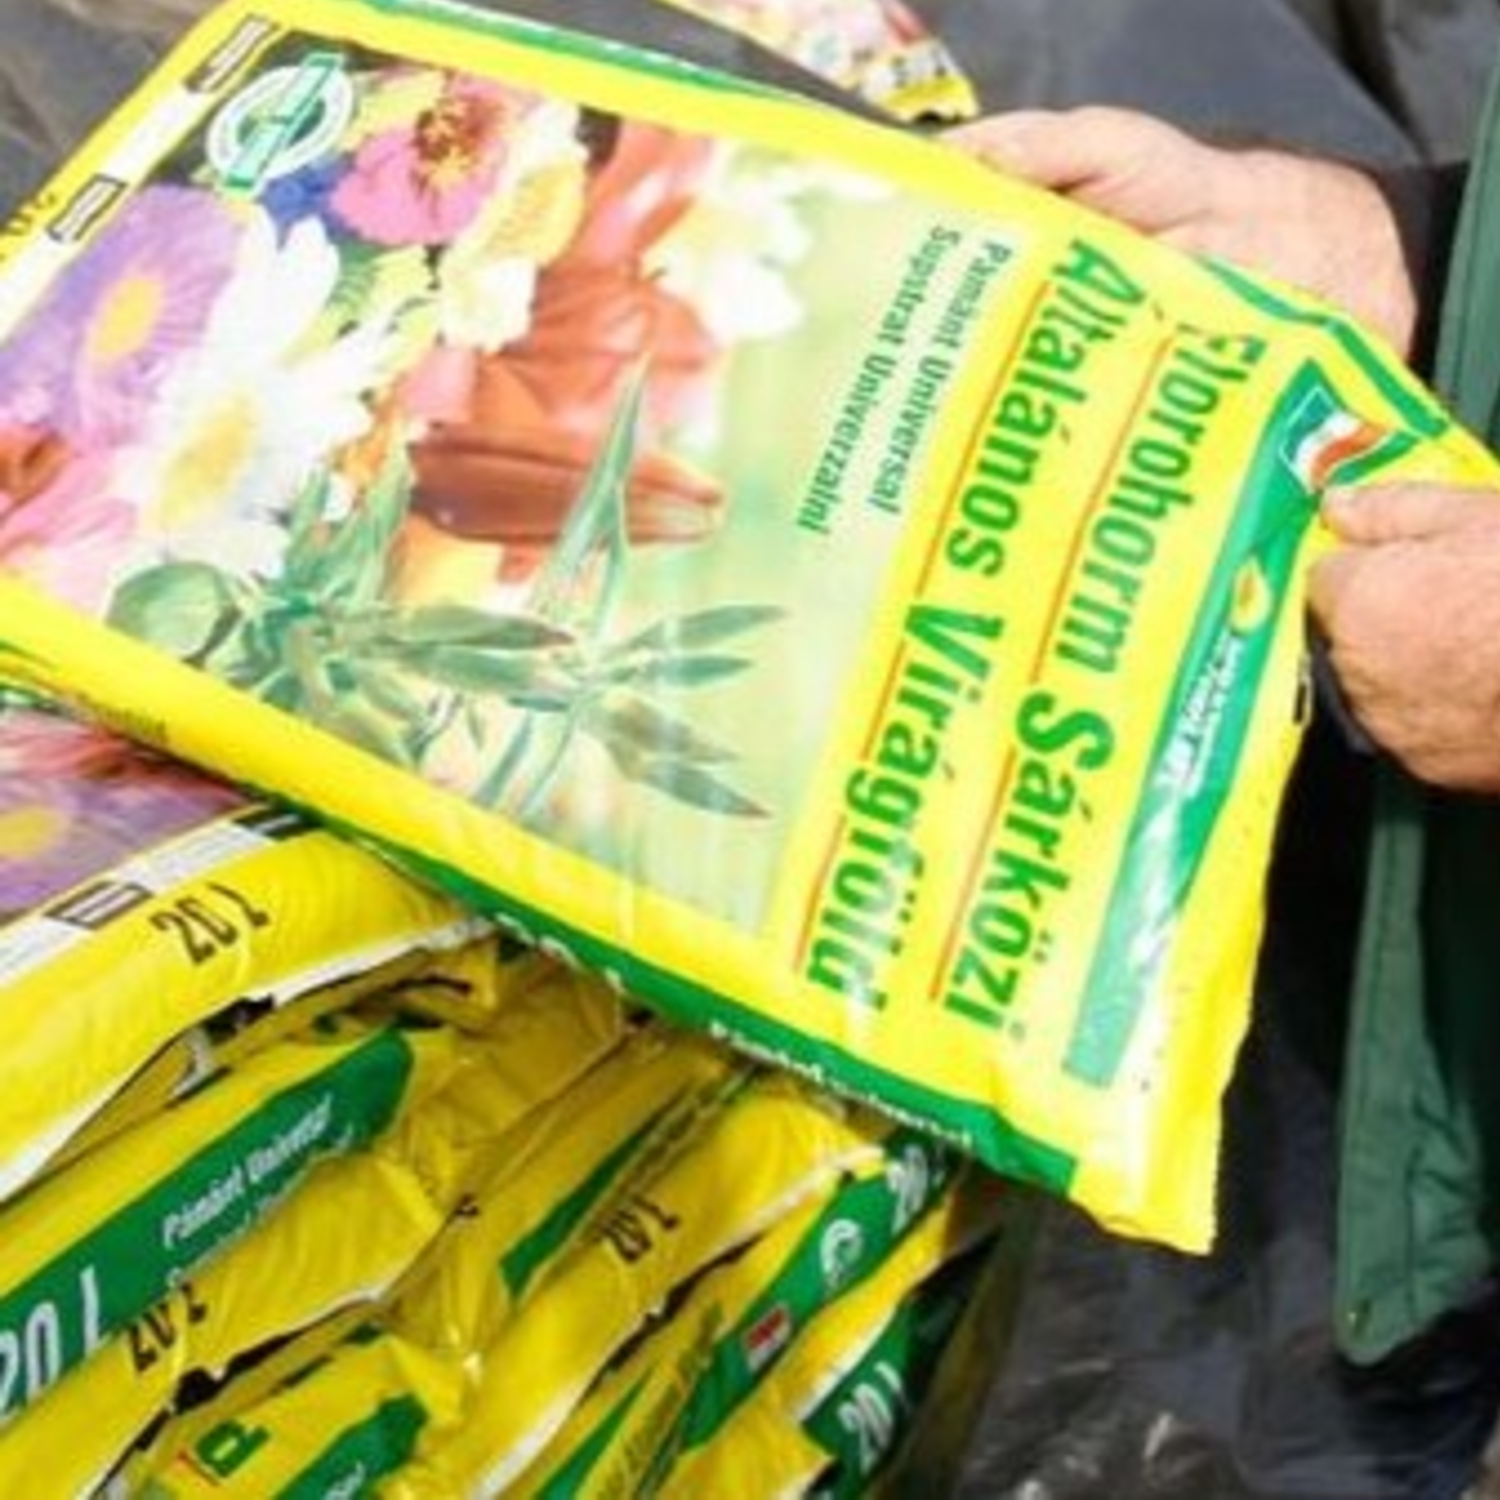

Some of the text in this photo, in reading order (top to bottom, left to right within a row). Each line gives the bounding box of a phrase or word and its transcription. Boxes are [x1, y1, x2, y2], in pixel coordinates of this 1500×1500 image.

[867, 355, 954, 515] Universal
[148, 896, 238, 965] 20
[805, 603, 1004, 1012] Virágföld
[944, 690, 1114, 1039] Sárközi
